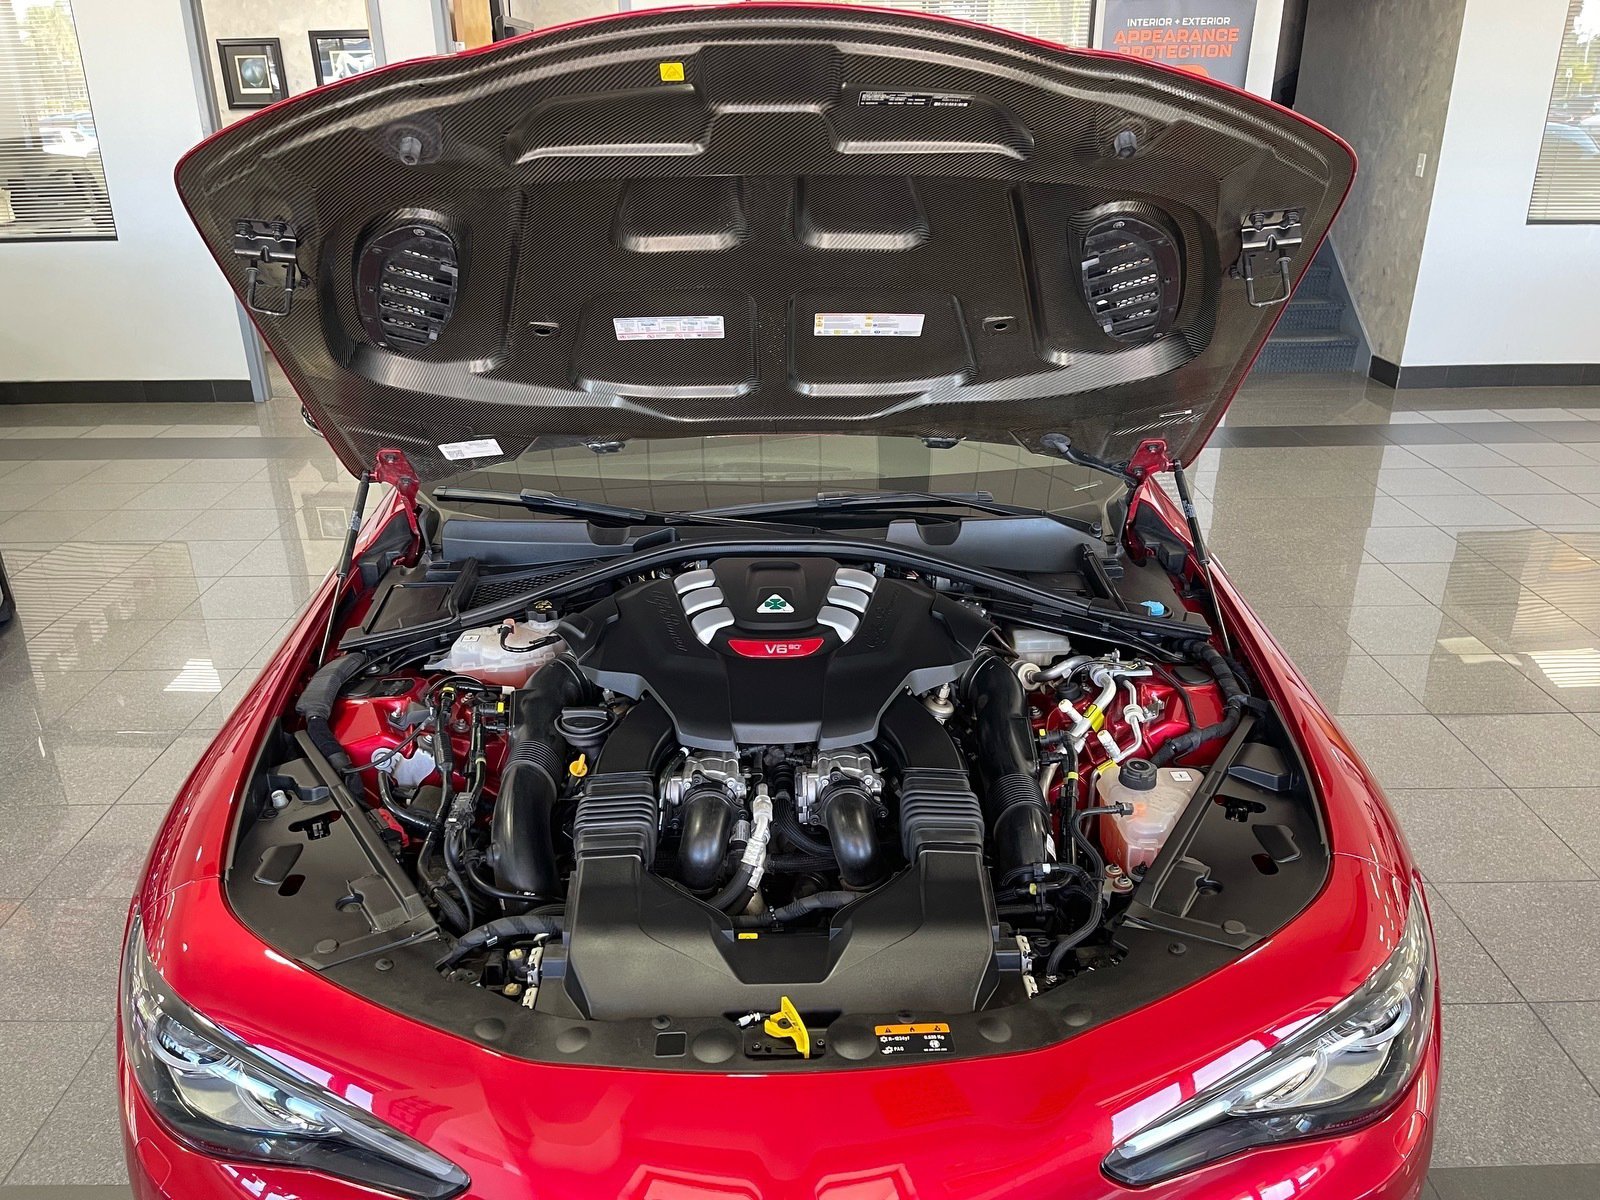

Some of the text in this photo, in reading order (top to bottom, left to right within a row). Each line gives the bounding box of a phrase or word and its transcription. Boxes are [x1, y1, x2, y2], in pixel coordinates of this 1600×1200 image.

[1127, 18, 1172, 27] INTERIOR
[1182, 16, 1231, 26] EXTERIOR
[1114, 28, 1239, 44] APPEARANCE
[1119, 44, 1232, 59] PROTECTION
[764, 643, 788, 654] V6
